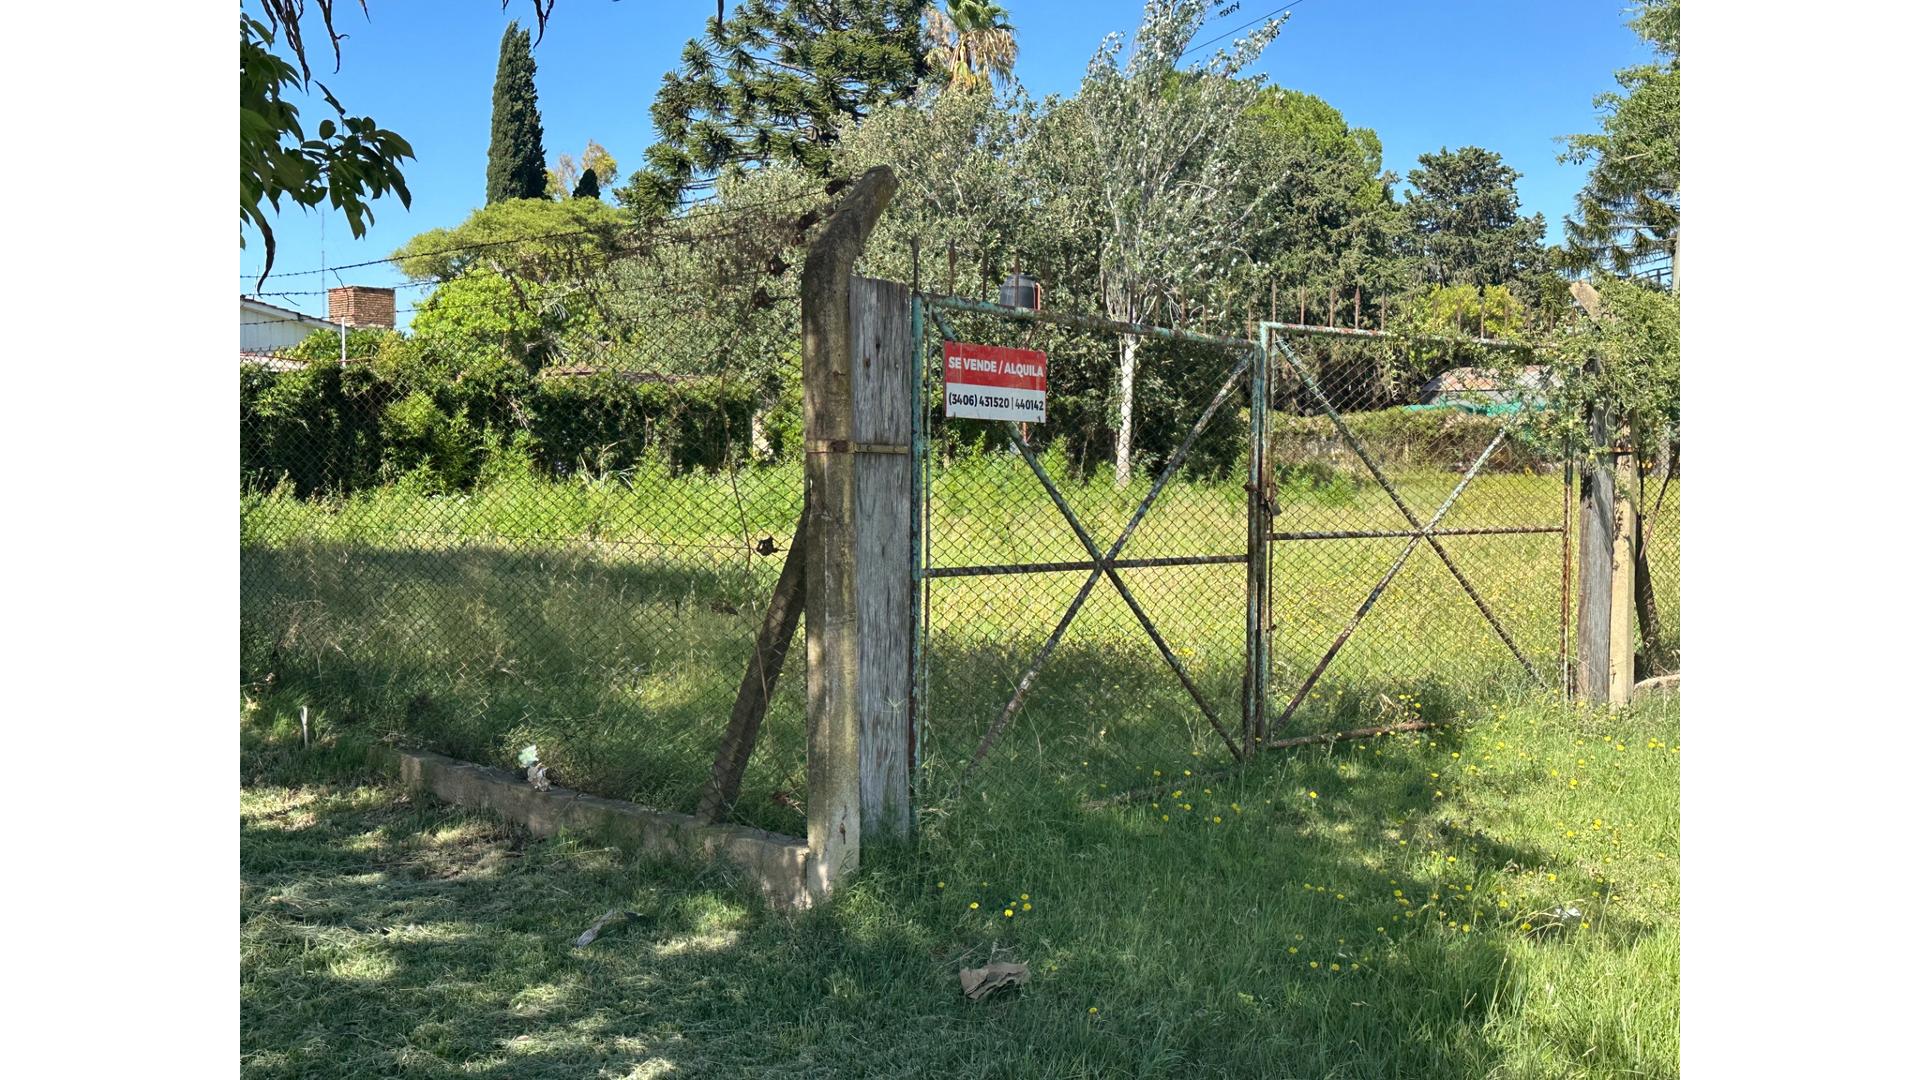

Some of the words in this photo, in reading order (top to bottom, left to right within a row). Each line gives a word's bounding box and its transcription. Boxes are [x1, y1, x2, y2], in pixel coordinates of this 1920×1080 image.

[948, 356, 961, 369] SE
[963, 358, 997, 373] VENDE
[1004, 362, 1044, 377] ALQUILA
[948, 392, 977, 407] (3406)
[979, 395, 1009, 408] 431520
[1015, 398, 1044, 411] 440142
